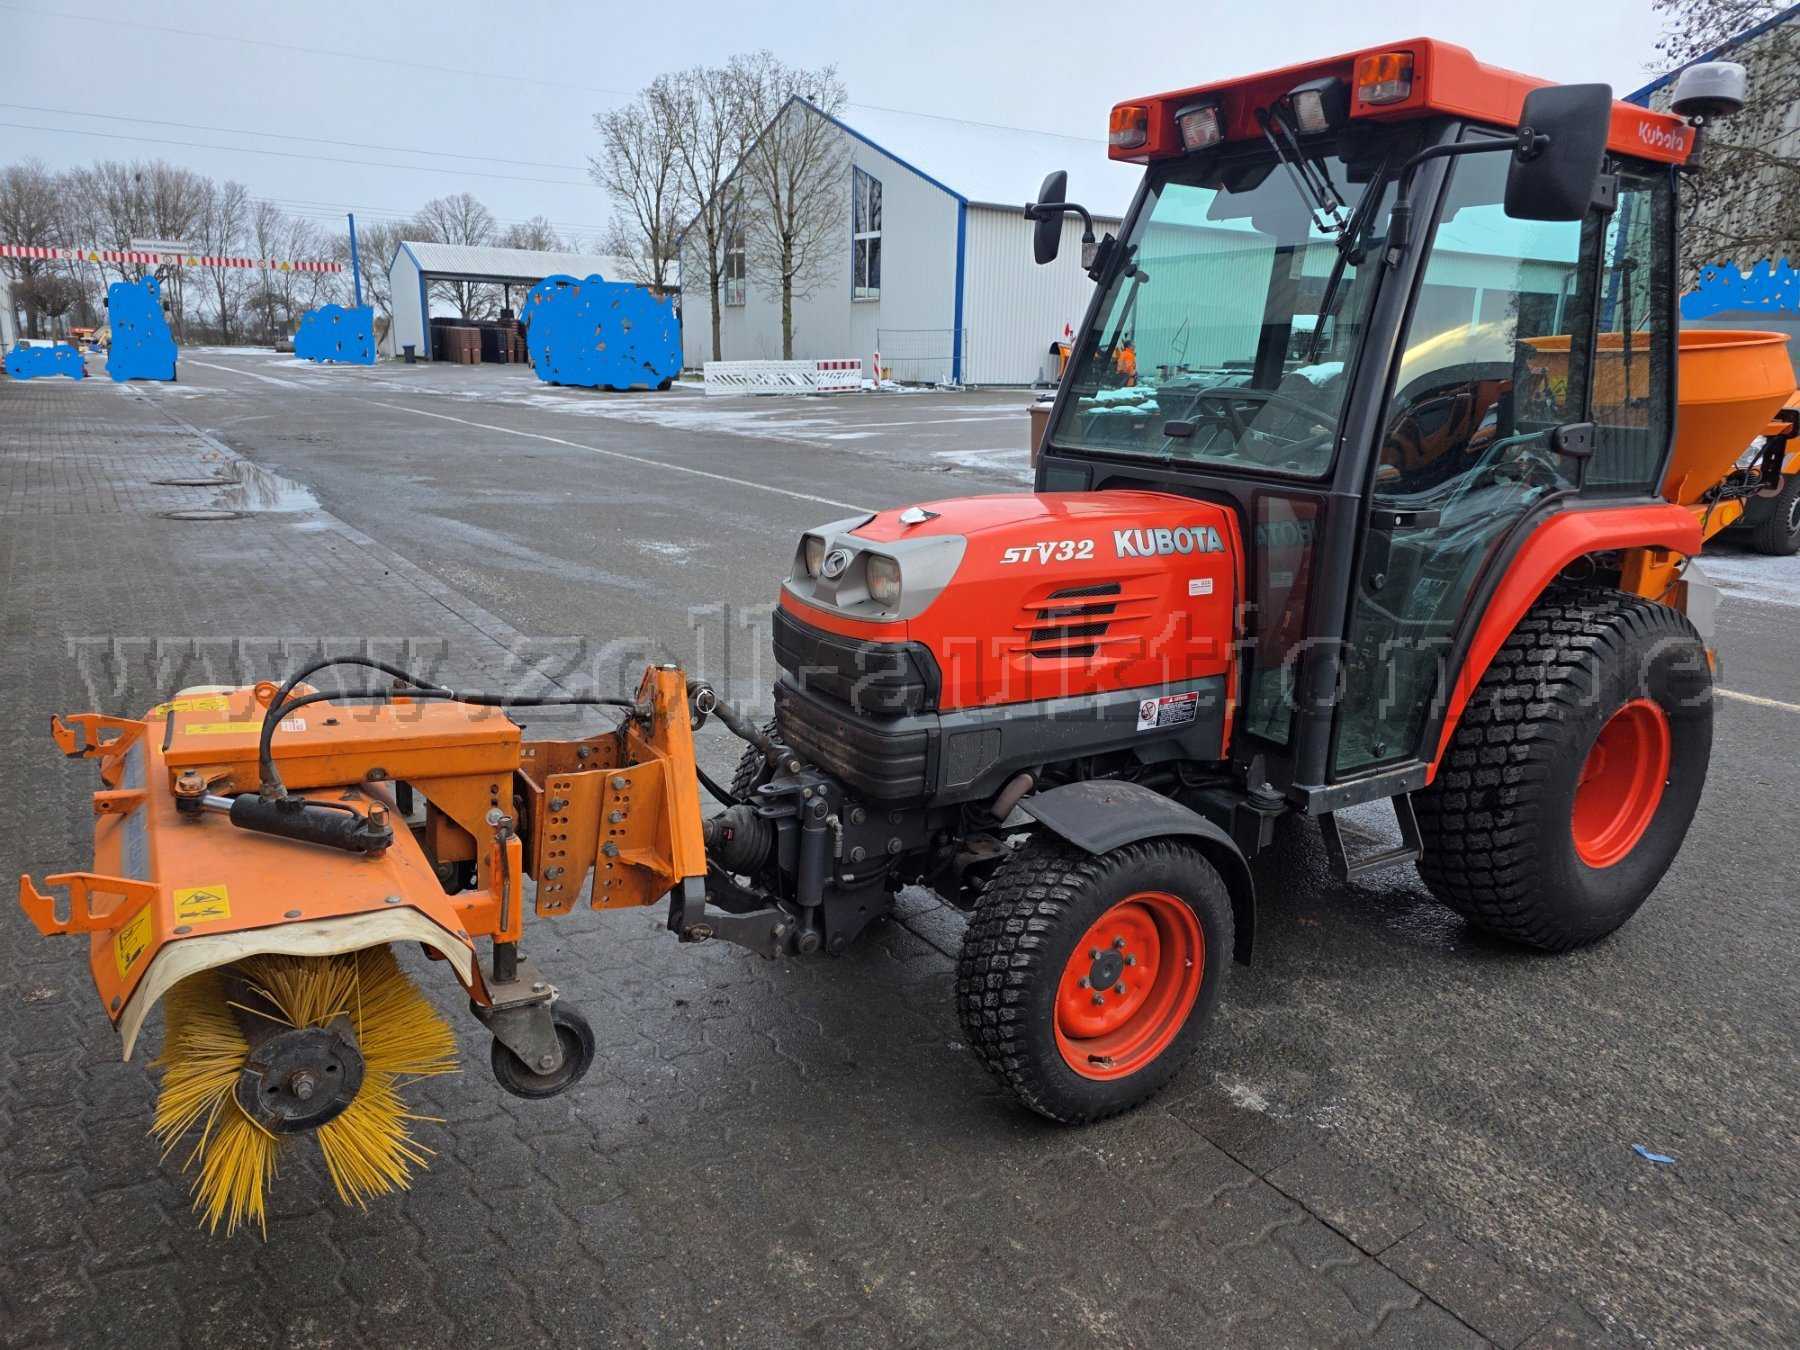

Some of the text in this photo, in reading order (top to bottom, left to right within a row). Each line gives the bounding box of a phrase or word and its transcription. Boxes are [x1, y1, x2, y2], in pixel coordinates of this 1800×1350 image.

[1638, 121, 1683, 151] Kubota
[1000, 539, 1094, 565] STV32
[1113, 526, 1224, 558] KUBOTA
